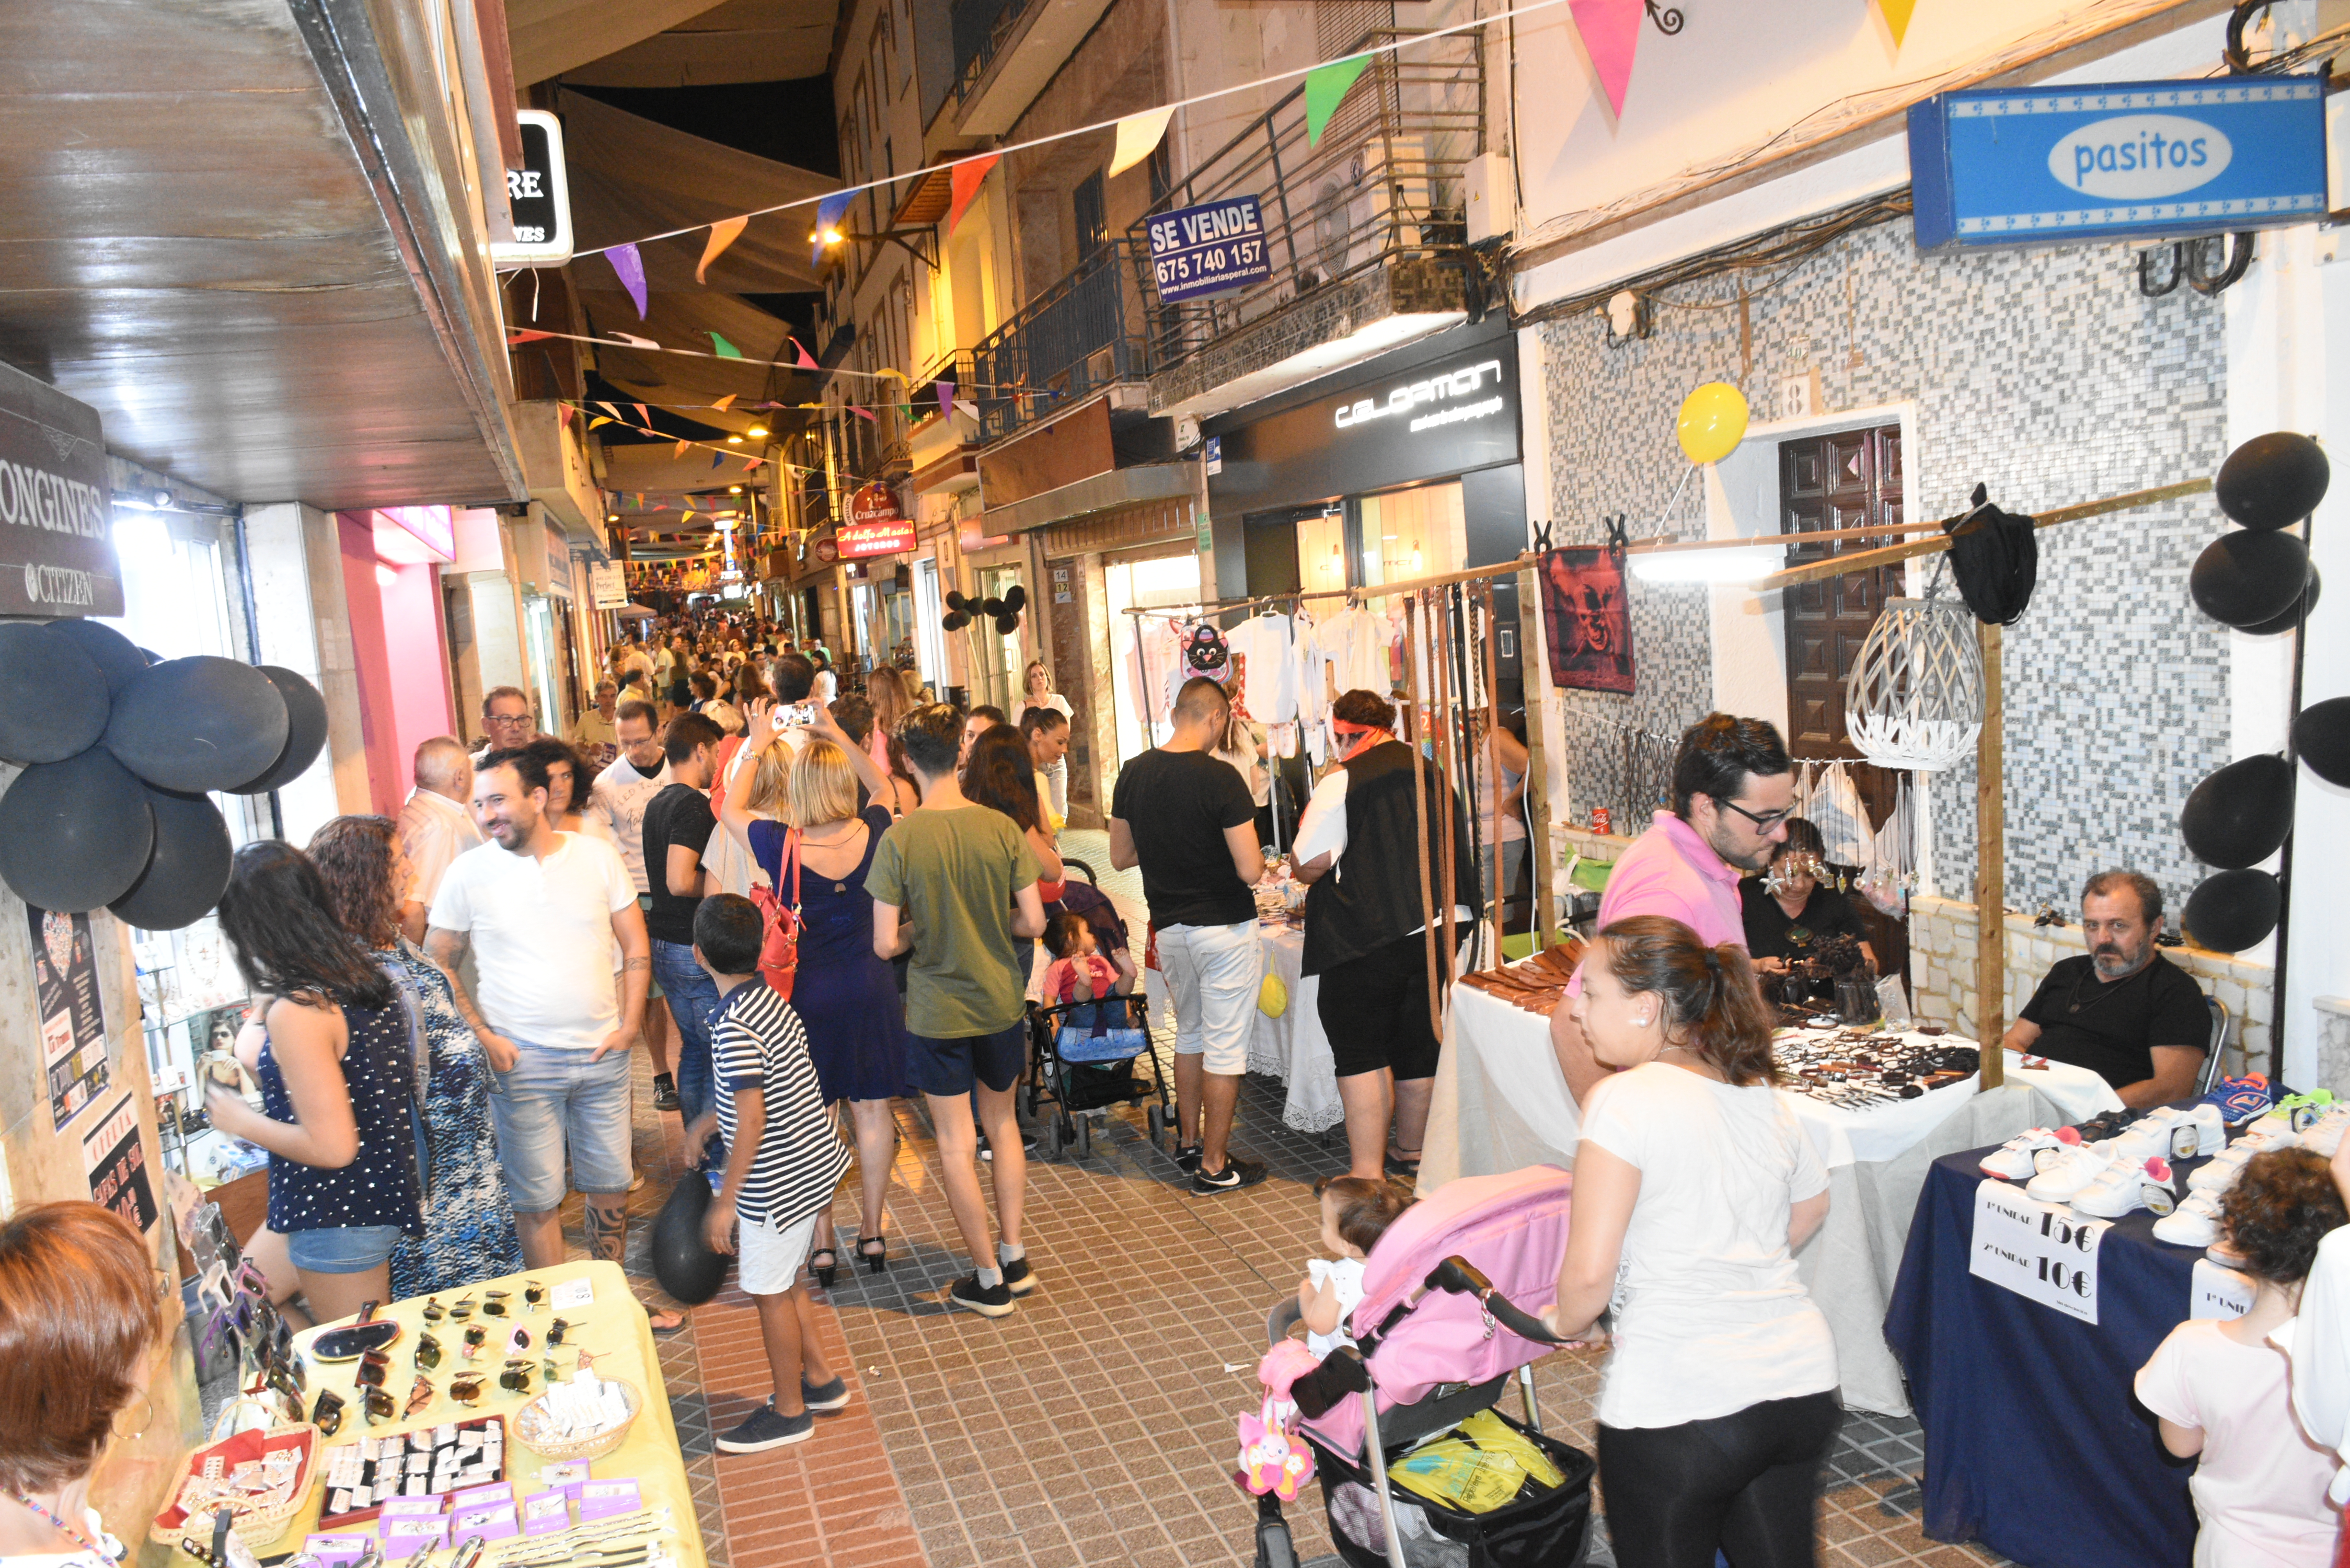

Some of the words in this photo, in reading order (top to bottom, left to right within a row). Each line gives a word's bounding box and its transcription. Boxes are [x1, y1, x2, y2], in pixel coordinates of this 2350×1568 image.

[2075, 131, 2208, 187] pasitos
[1151, 220, 1180, 252] SE
[1182, 203, 1258, 244] VENDE
[1157, 256, 1189, 283] 675
[1192, 249, 1226, 274] 740
[1231, 240, 1262, 266] 157
[1160, 264, 1267, 295] www.inmobiliariasperal.com
[1788, 384, 1802, 415] 8
[0, 459, 106, 541] ONGINES
[855, 506, 898, 520] Cruzcampo
[838, 528, 876, 541] Adolfo
[38, 564, 94, 605] CITIZEN
[1056, 571, 1066, 580] 14
[1997, 1204, 2032, 1225] UNIDAD
[2040, 1211, 2094, 1253] 15€
[1995, 1247, 2030, 1268] UNIDAD
[2036, 1256, 2092, 1298] 10€
[2219, 1297, 2247, 1315] UNID
